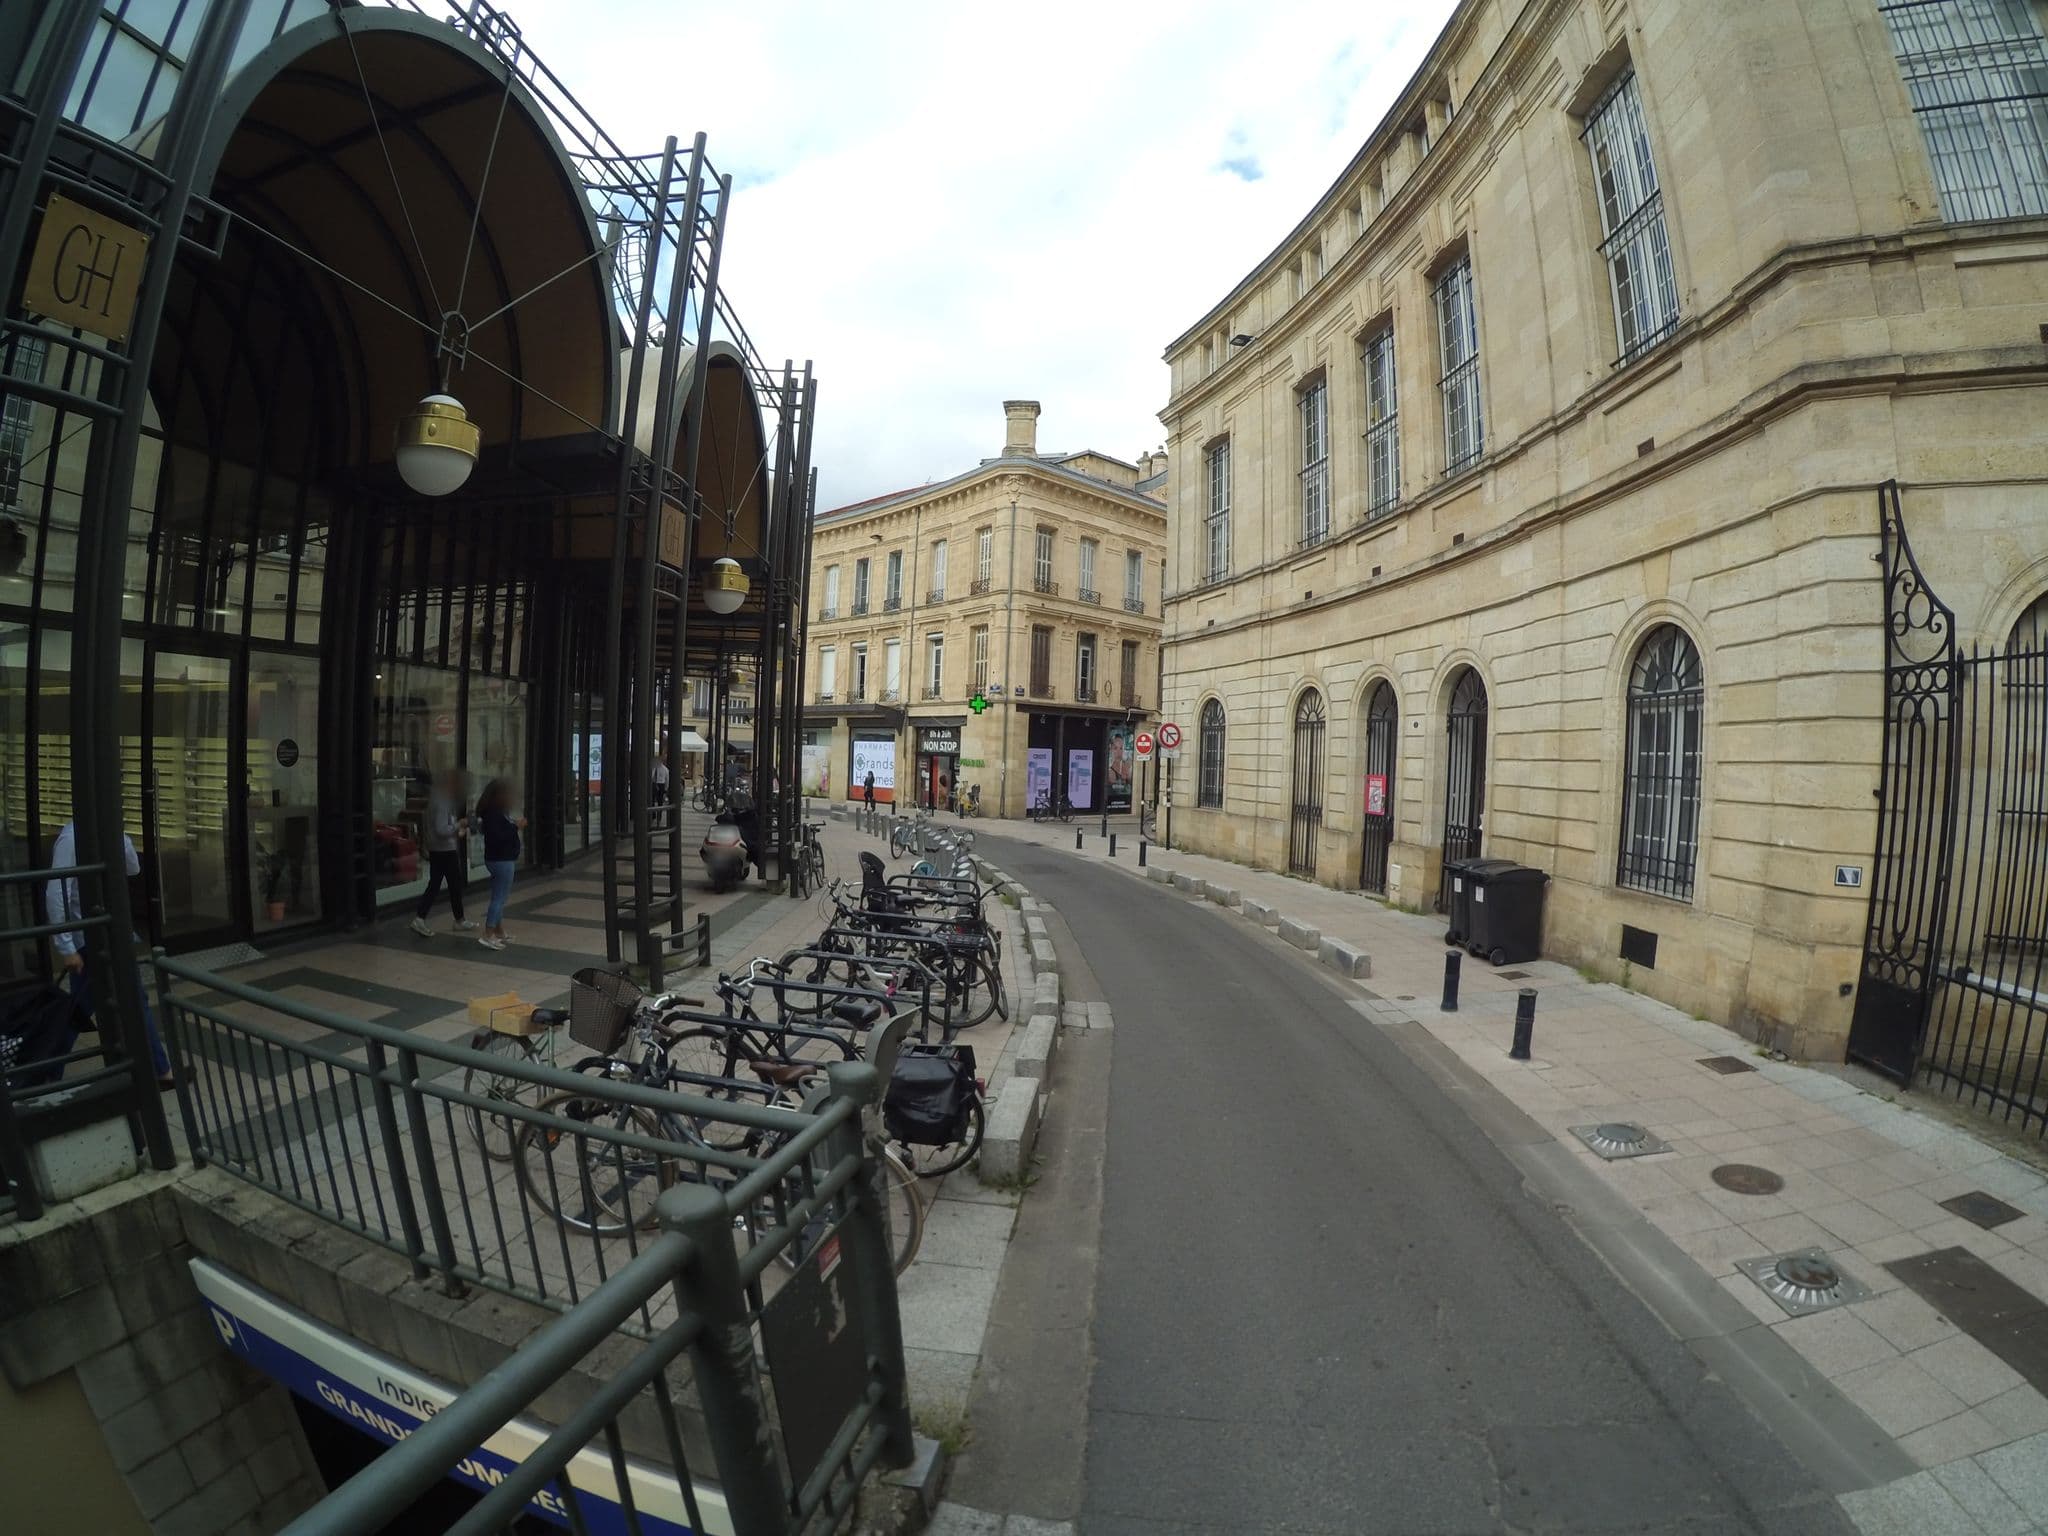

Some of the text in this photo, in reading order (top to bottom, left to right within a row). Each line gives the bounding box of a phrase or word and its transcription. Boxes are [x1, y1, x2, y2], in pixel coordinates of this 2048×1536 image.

[53, 223, 126, 317] GH
[923, 741, 958, 751] NON STOP
[210, 1307, 236, 1346] P
